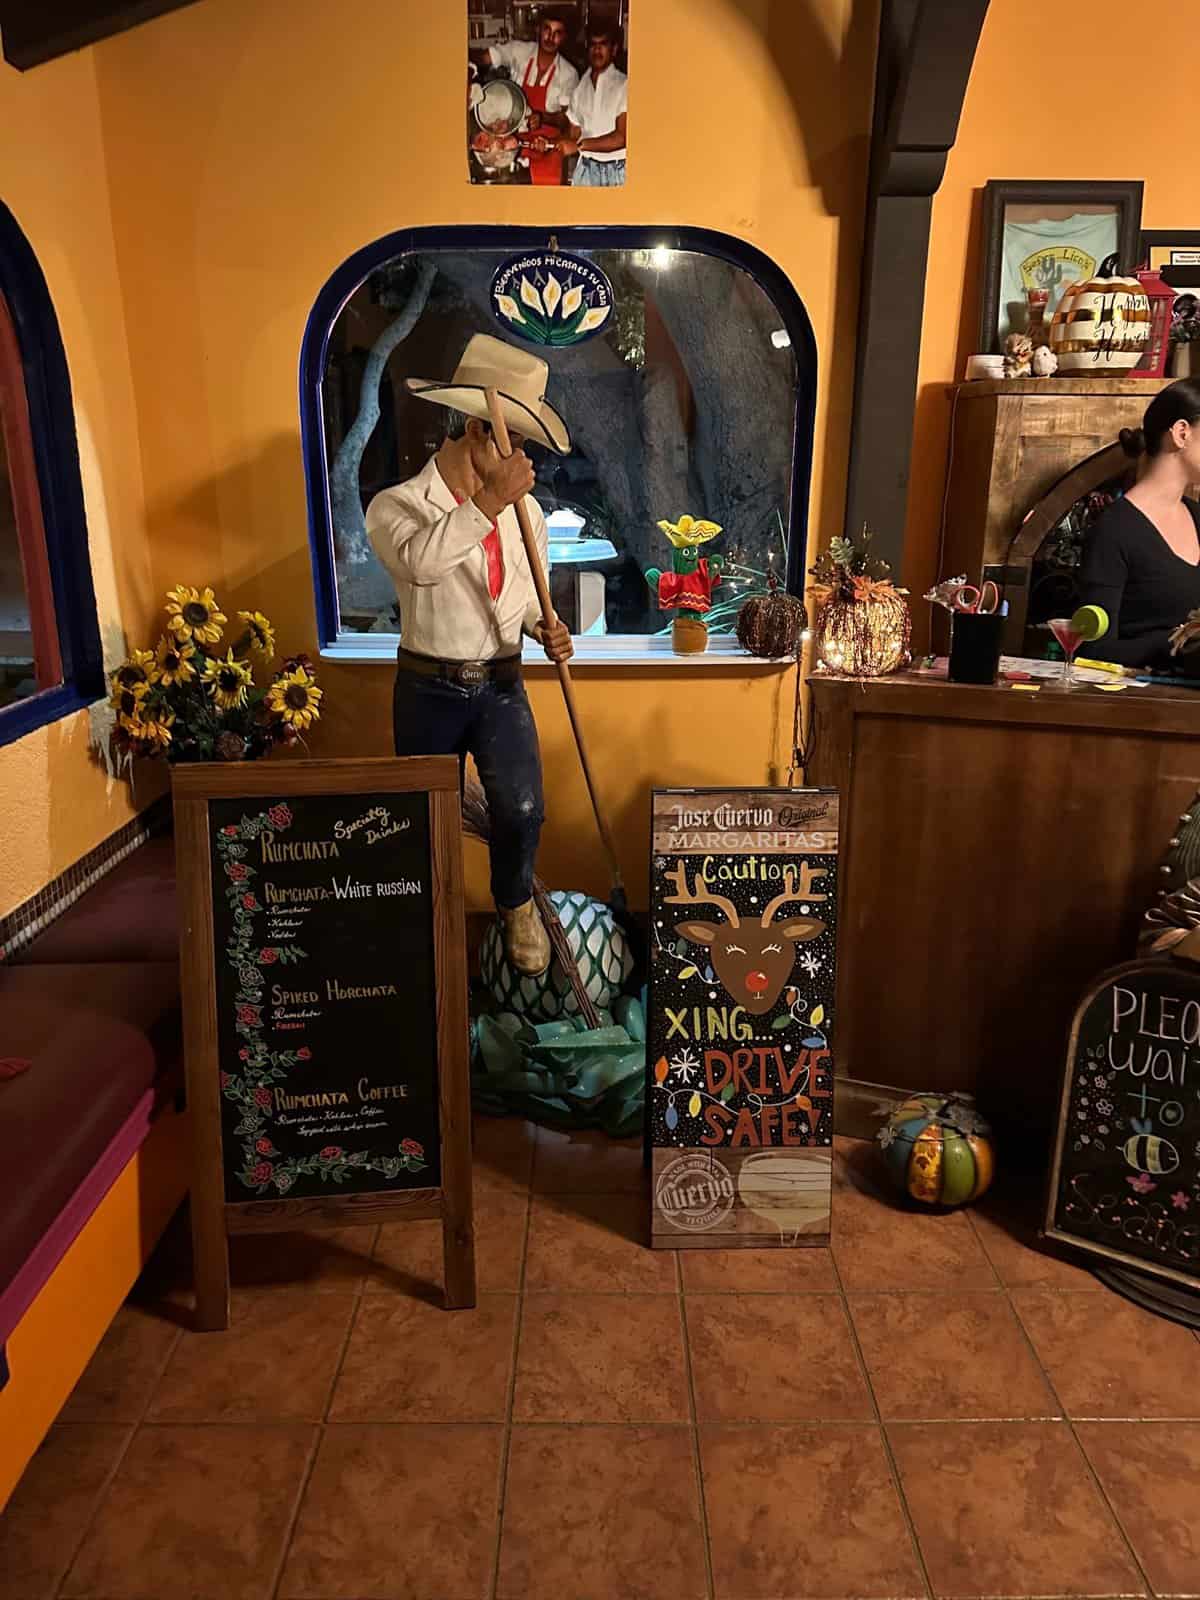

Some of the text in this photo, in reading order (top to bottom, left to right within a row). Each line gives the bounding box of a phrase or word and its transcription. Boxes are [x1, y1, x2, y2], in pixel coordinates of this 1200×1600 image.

[670, 803, 711, 832] Jose
[713, 802, 774, 831] Cuervo
[667, 832, 826, 850] MARGARITAS
[702, 855, 799, 884] Caution
[704, 1047, 832, 1098] DRIVE
[656, 1176, 736, 1216] Cuervo
